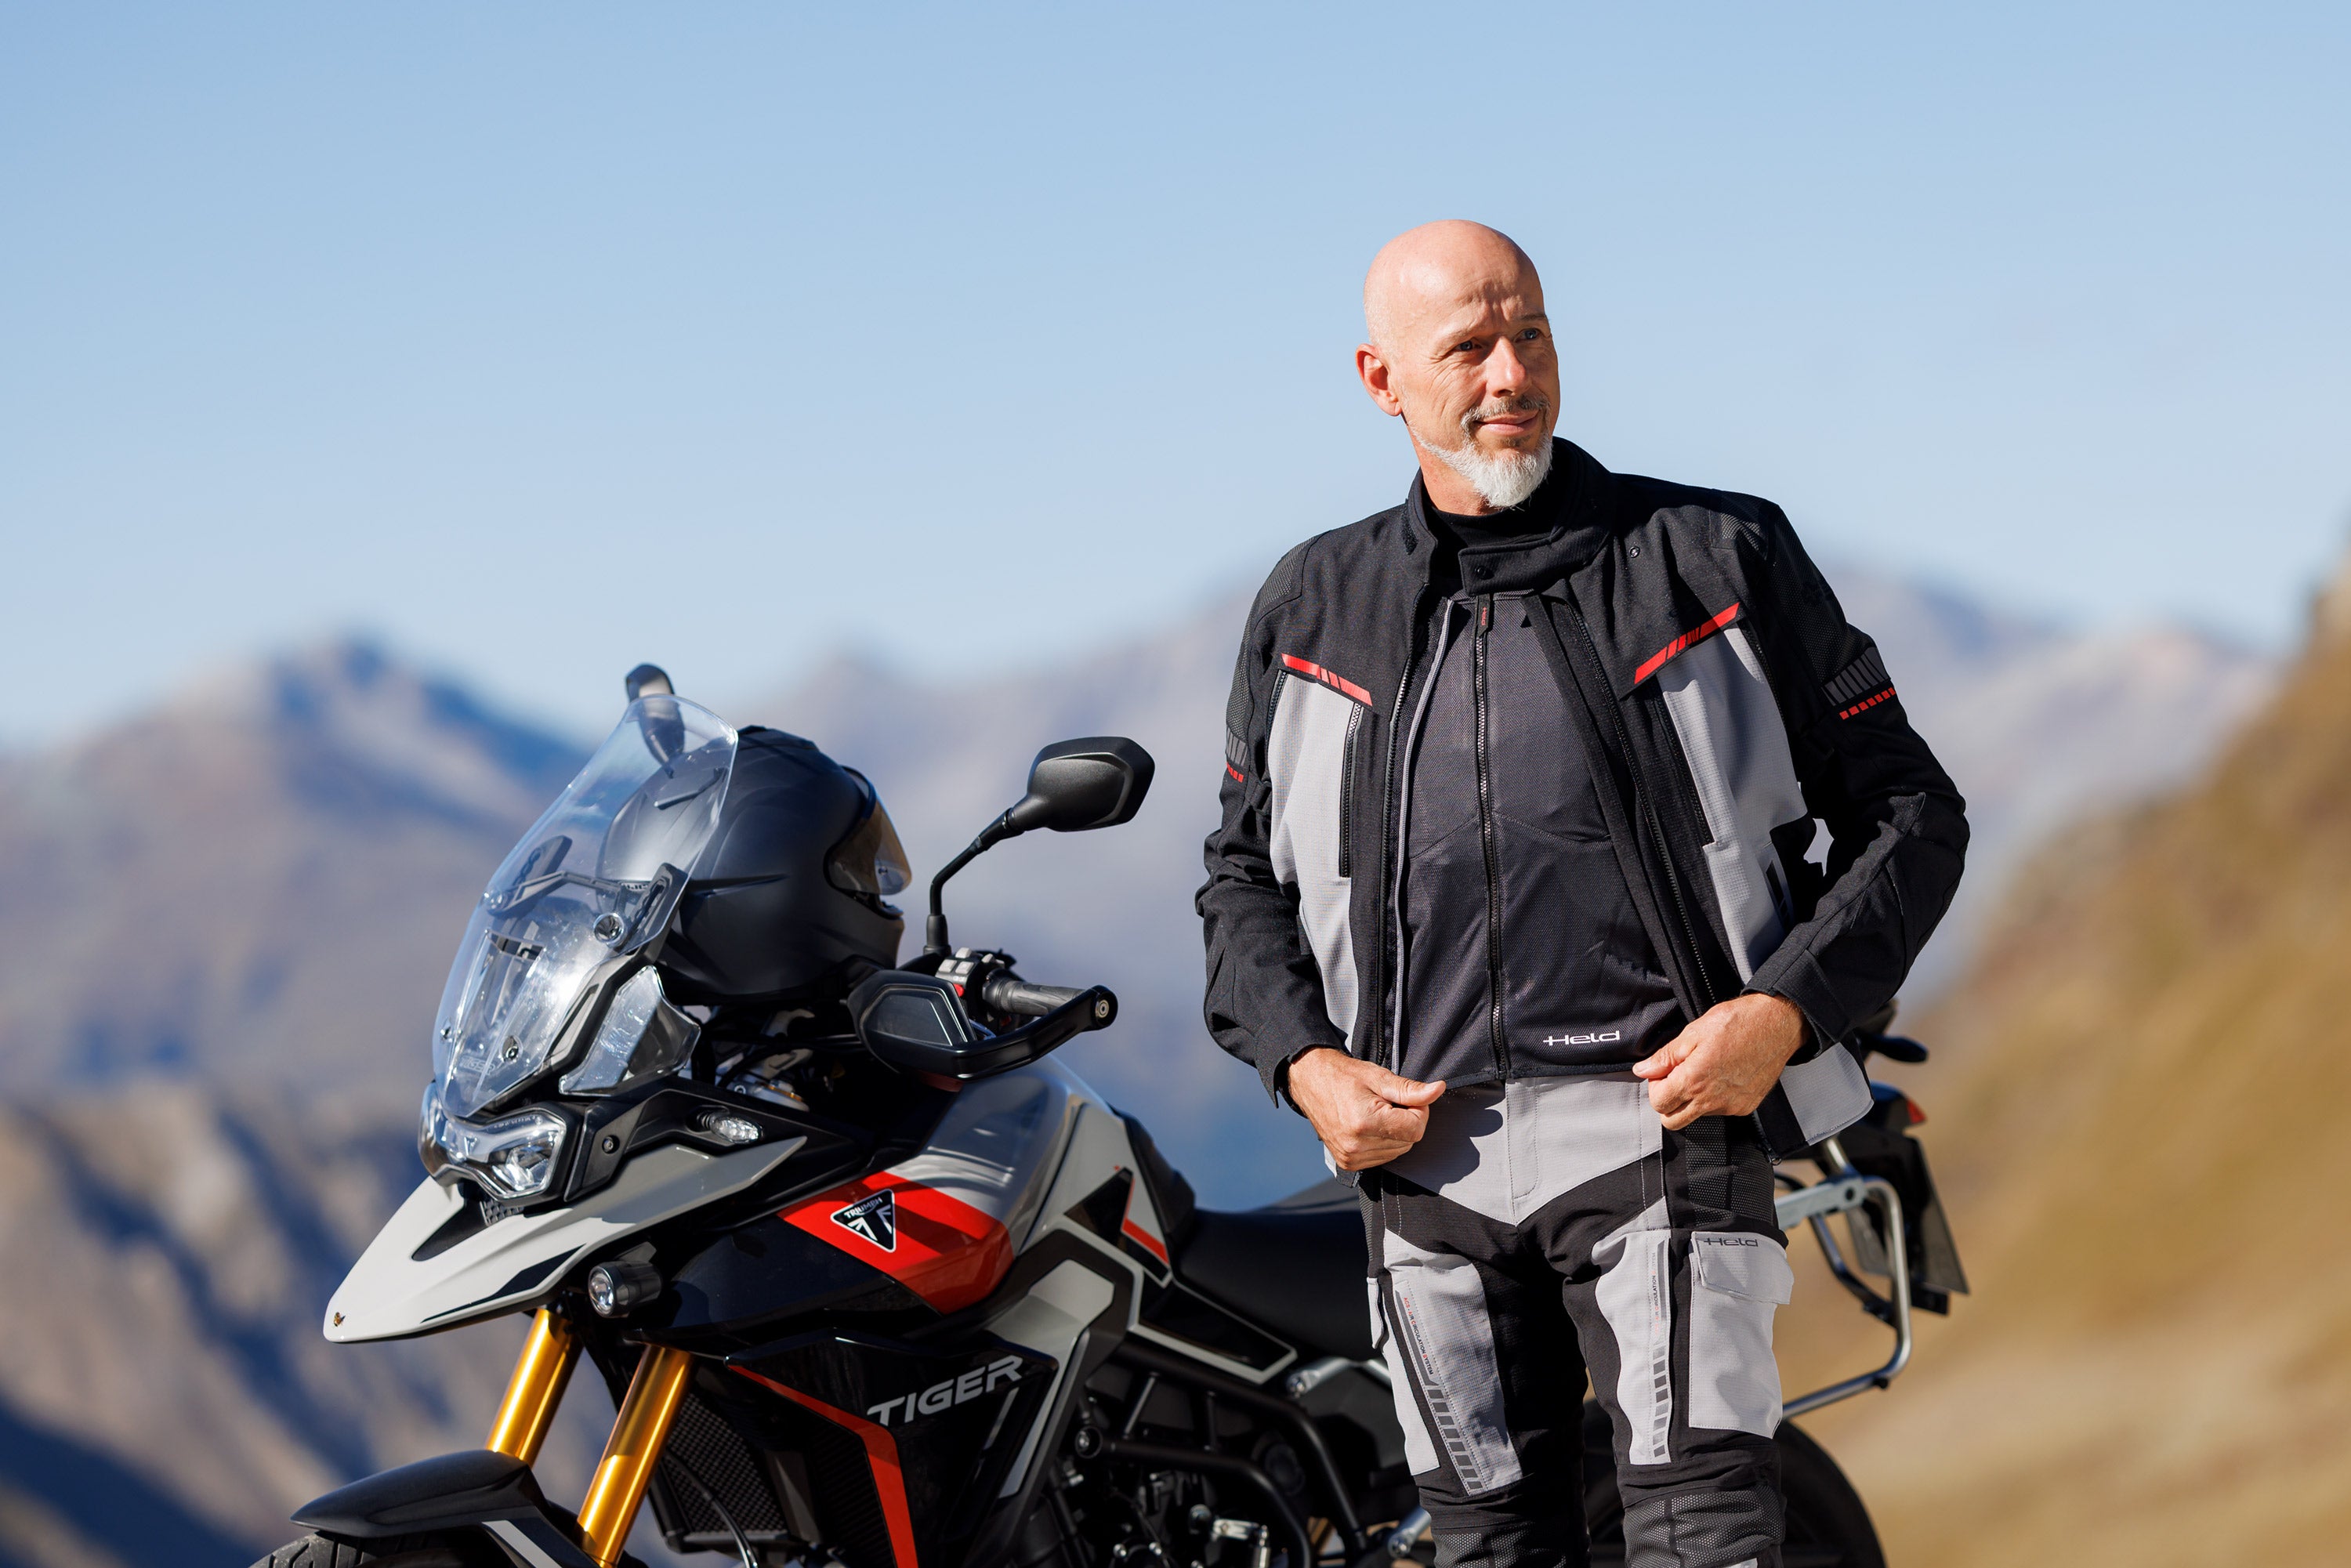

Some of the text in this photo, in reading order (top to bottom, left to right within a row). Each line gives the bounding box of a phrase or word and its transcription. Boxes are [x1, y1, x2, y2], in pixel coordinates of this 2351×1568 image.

[1543, 1030, 1621, 1046] Held
[844, 1197, 883, 1219] TRIUMPH
[1703, 1237, 1759, 1248] Held
[1411, 1320, 1426, 1354] CIRCULATION
[1422, 1353, 1434, 1375] SYSTEM
[867, 1355, 1023, 1426] TIGER
